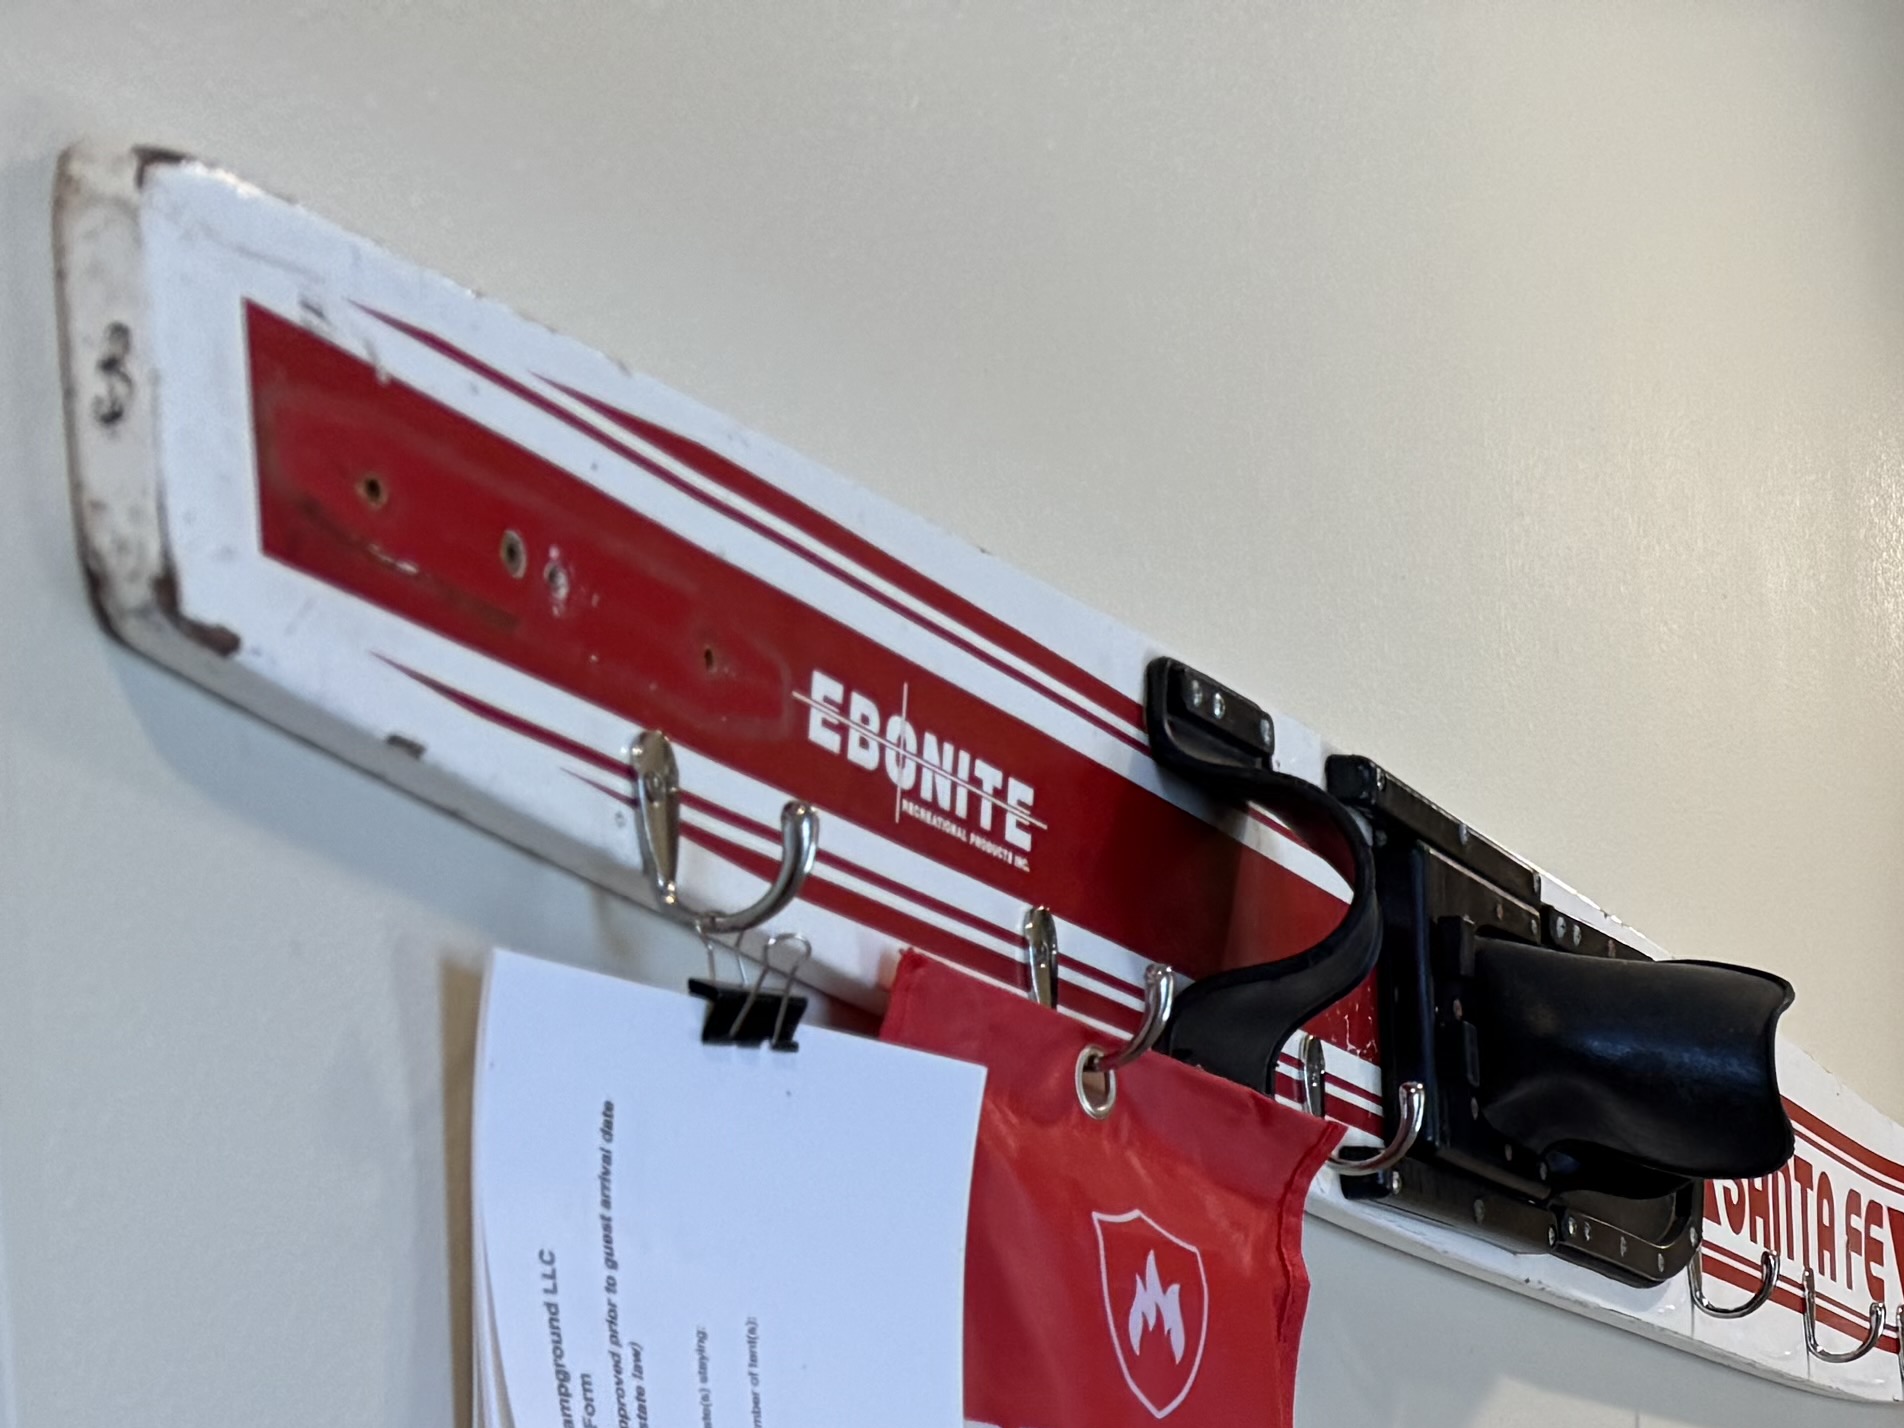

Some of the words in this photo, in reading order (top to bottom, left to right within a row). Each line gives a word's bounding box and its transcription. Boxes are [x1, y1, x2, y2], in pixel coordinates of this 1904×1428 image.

[808, 669, 1035, 853] EBONITE
[600, 1100, 614, 1143] date
[598, 1147, 612, 1210] arrival
[600, 1213, 618, 1270] guest
[1845, 1188, 1886, 1303] FE
[538, 1249, 558, 1295] LLC
[605, 1275, 617, 1294] to
[605, 1300, 623, 1349] prior
[628, 1341, 643, 1380] law)
[748, 1371, 760, 1387] of
